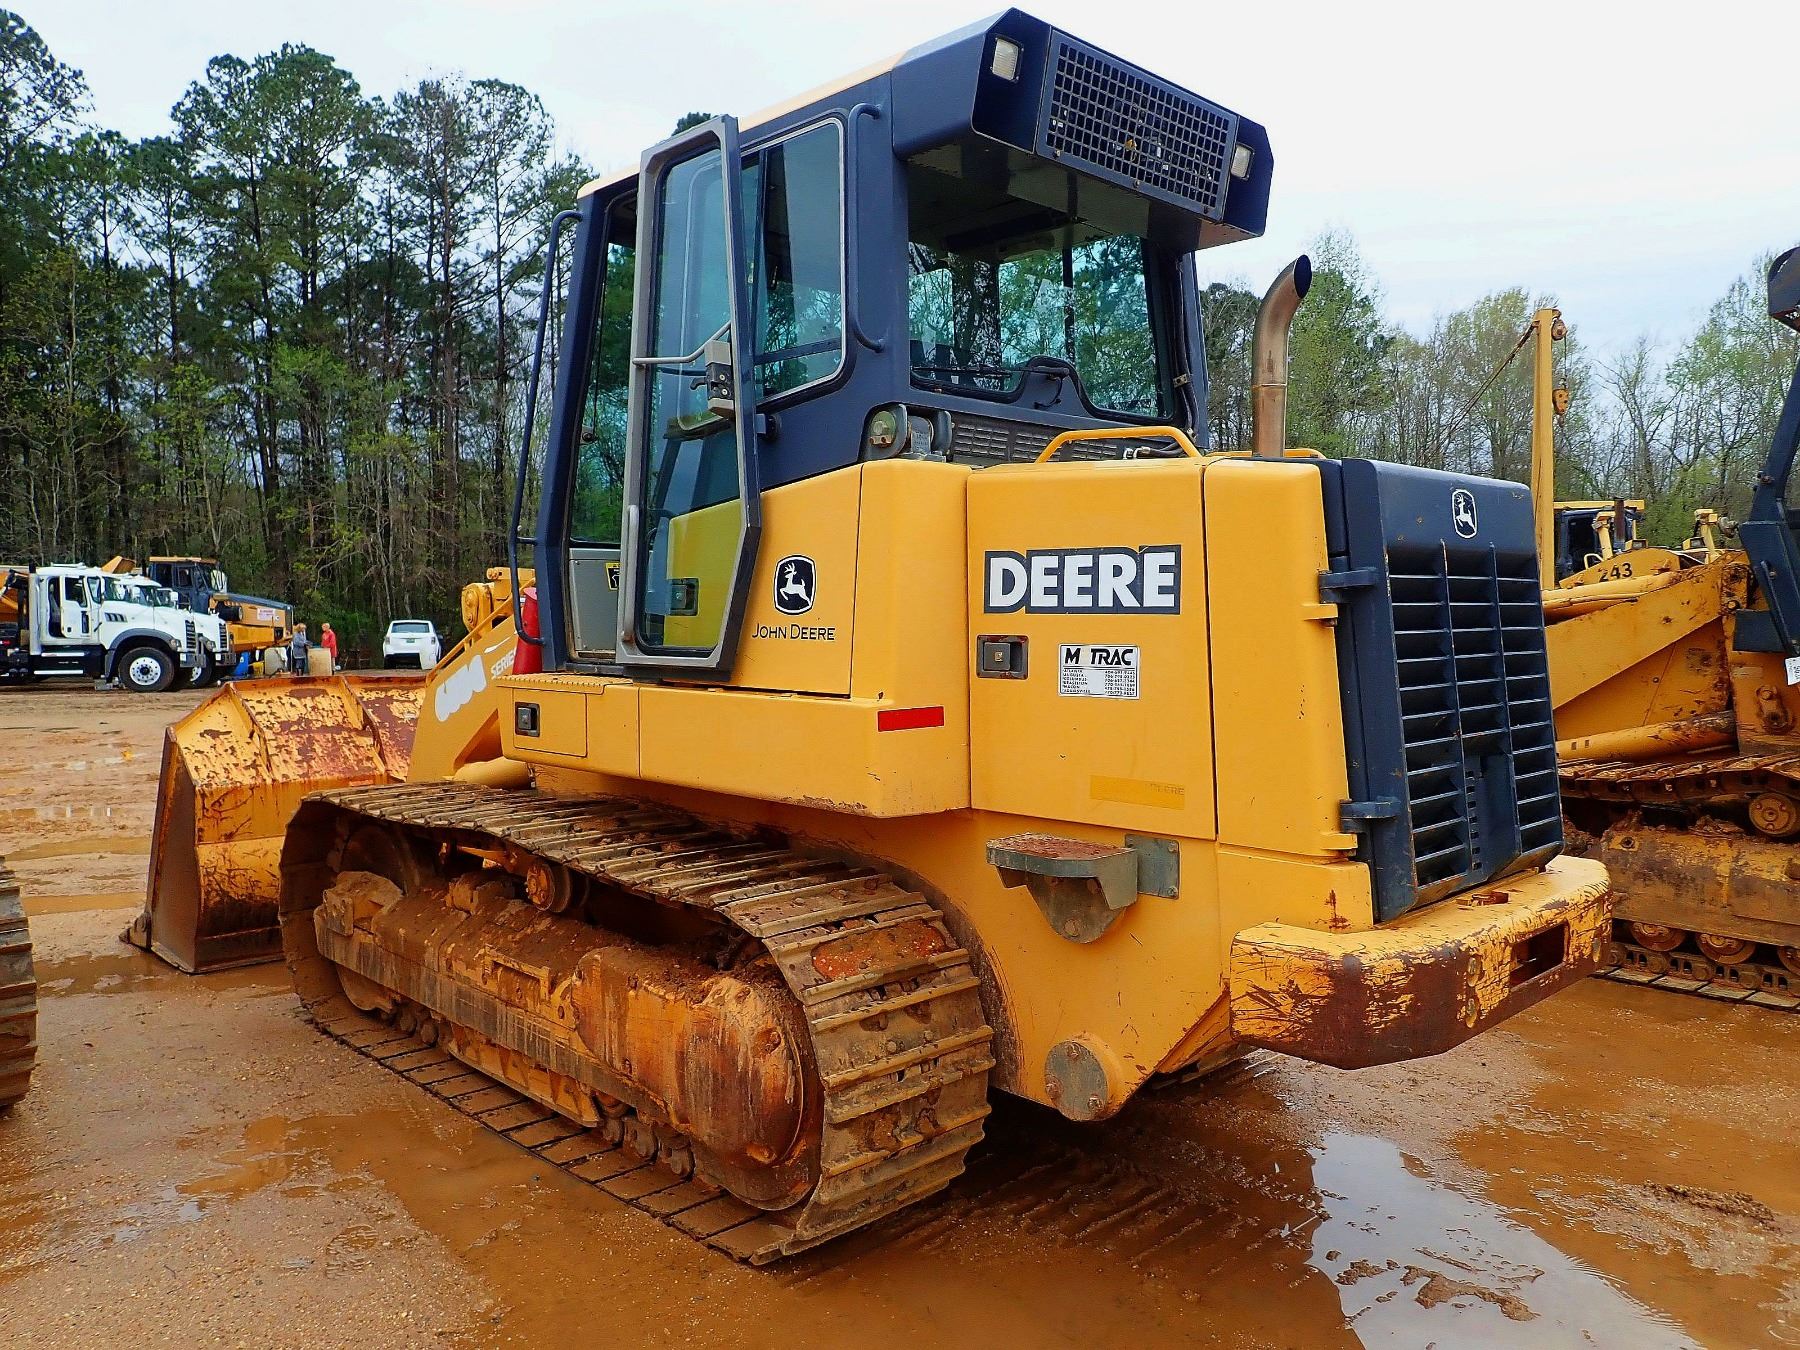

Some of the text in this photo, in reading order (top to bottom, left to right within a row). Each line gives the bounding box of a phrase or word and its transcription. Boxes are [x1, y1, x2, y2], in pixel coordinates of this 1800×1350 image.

[989, 551, 1176, 607] DEERE
[1598, 562, 1633, 583] 243
[752, 623, 836, 640] JOHN DEERE
[491, 647, 516, 680] SERIE
